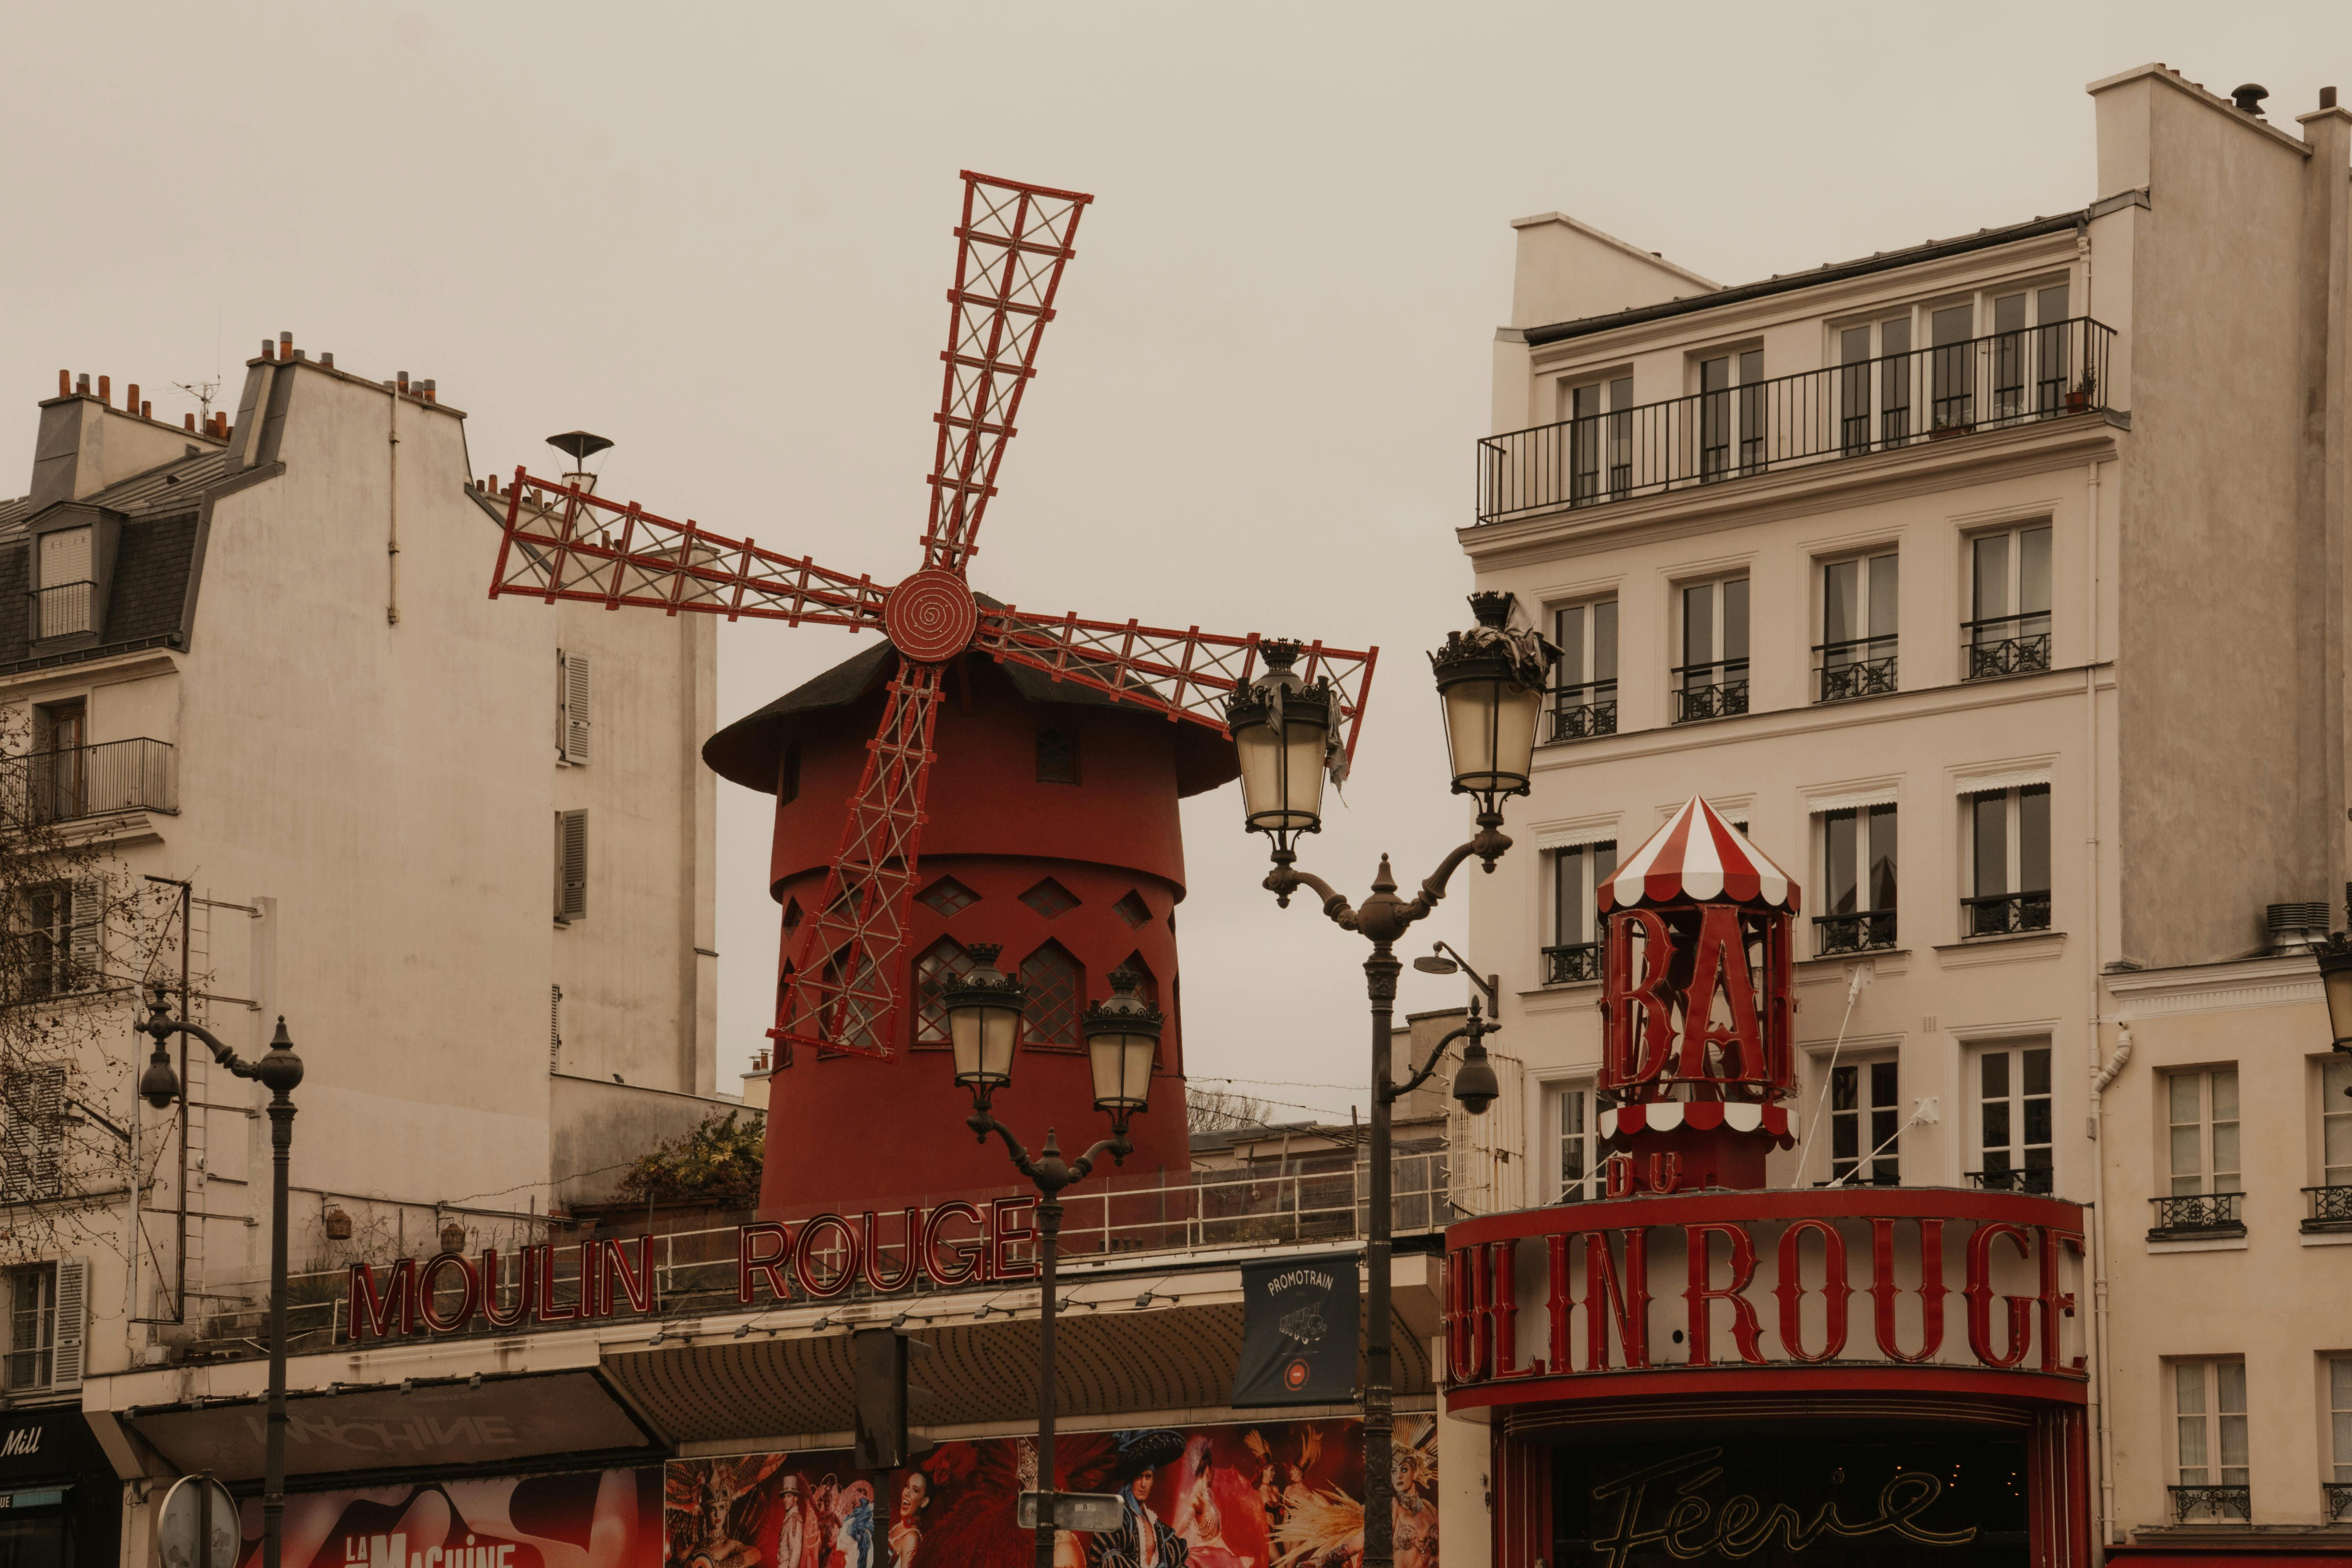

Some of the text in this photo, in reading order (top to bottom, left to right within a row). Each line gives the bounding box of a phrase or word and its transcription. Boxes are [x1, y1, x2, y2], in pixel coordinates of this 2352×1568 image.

[1606, 1152, 1682, 1200] DU
[347, 1195, 1040, 1339] MOULIN ROUGE
[1267, 1270, 1334, 1296] PROMOTRAIN
[1681, 1217, 2086, 1373] ROUGE
[0, 1426, 42, 1457] Mill
[346, 1537, 367, 1561] LA
